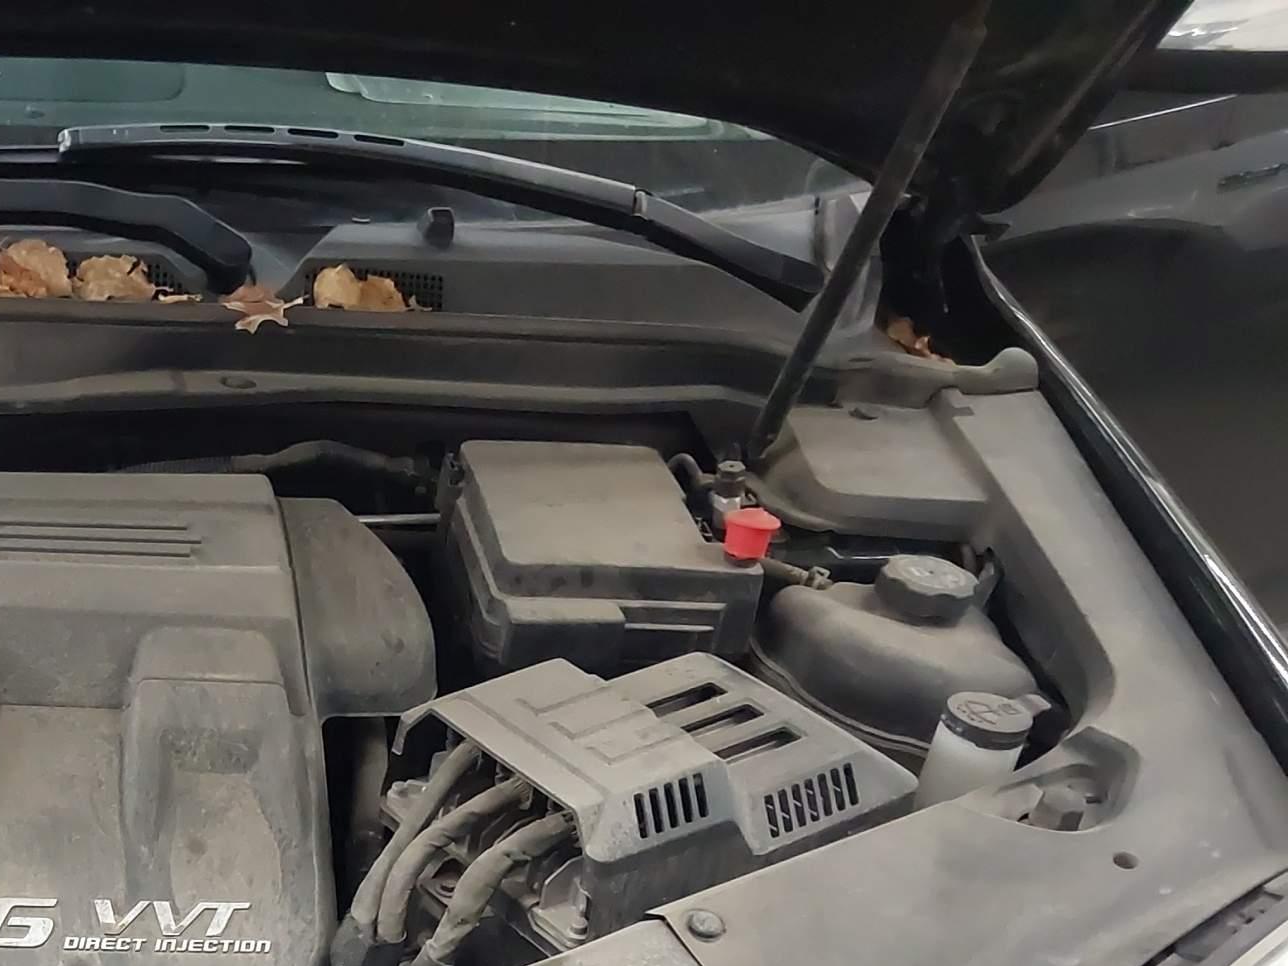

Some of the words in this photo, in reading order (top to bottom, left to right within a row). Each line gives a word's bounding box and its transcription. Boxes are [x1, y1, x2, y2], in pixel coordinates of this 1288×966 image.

[94, 899, 251, 937] VVT
[64, 936, 147, 951] DIRECT
[154, 939, 272, 953] INJECTION
